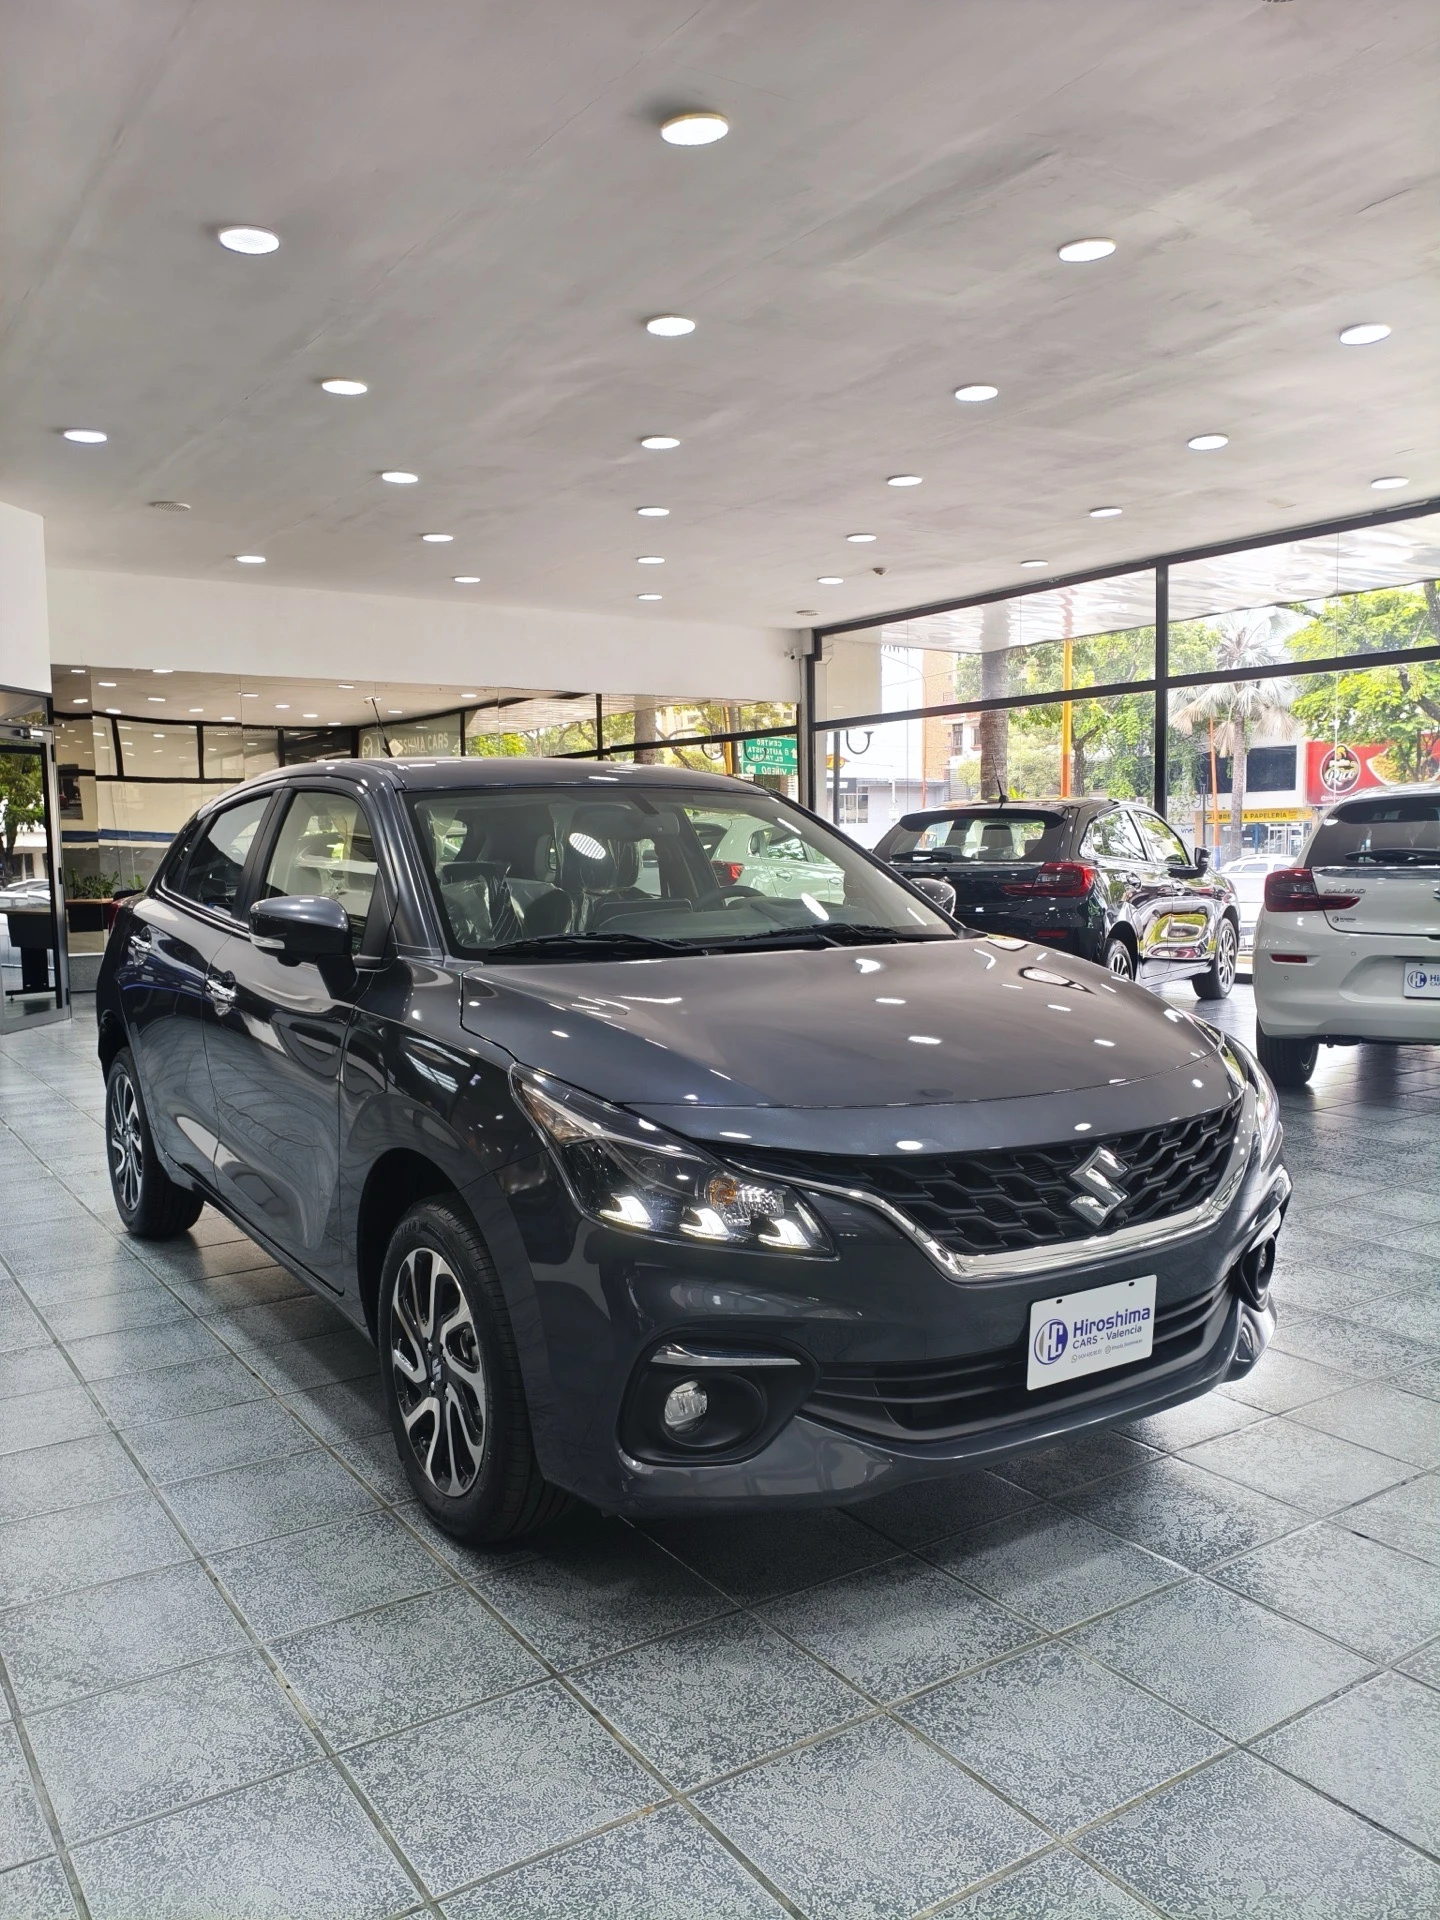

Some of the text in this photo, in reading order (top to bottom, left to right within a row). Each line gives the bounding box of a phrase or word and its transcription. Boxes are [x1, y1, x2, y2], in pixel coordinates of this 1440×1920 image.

[428, 732, 449, 750] CARS
[1073, 1307, 1151, 1338] Hiroshima
[1072, 1335, 1098, 1350] CARS
[1106, 1325, 1142, 1340] Valencia
